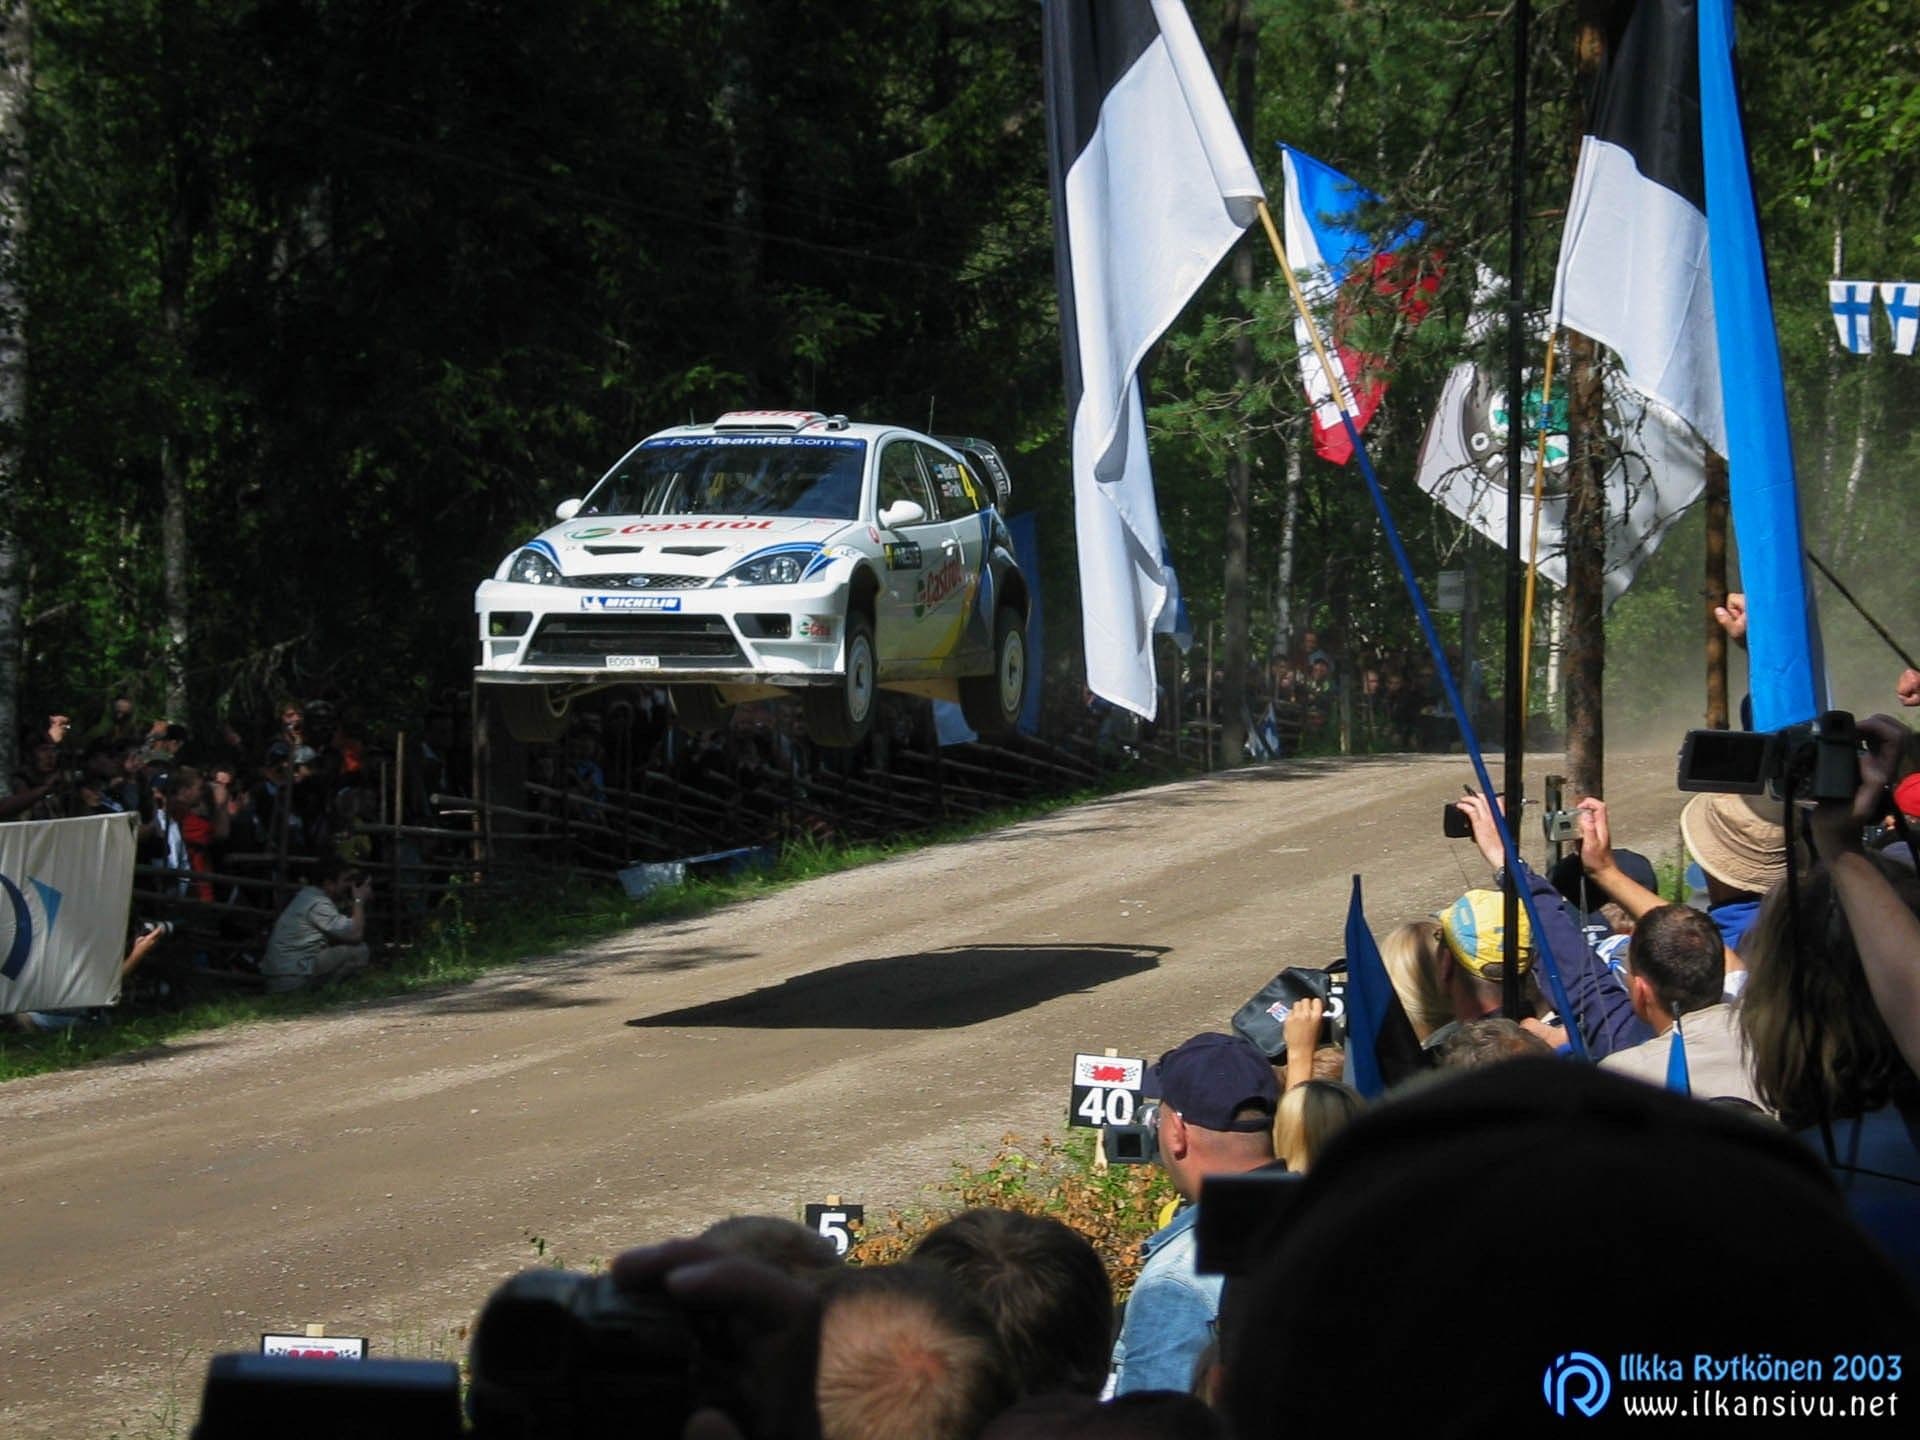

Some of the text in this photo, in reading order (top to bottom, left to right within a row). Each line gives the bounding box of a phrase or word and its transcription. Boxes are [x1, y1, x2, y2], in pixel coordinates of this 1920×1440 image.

[670, 437, 835, 446] FordTeamRS.com
[620, 520, 775, 535] Castrol
[604, 598, 678, 608] MICHELIN
[1078, 1087, 1134, 1126] 40
[819, 1212, 849, 1256] 5
